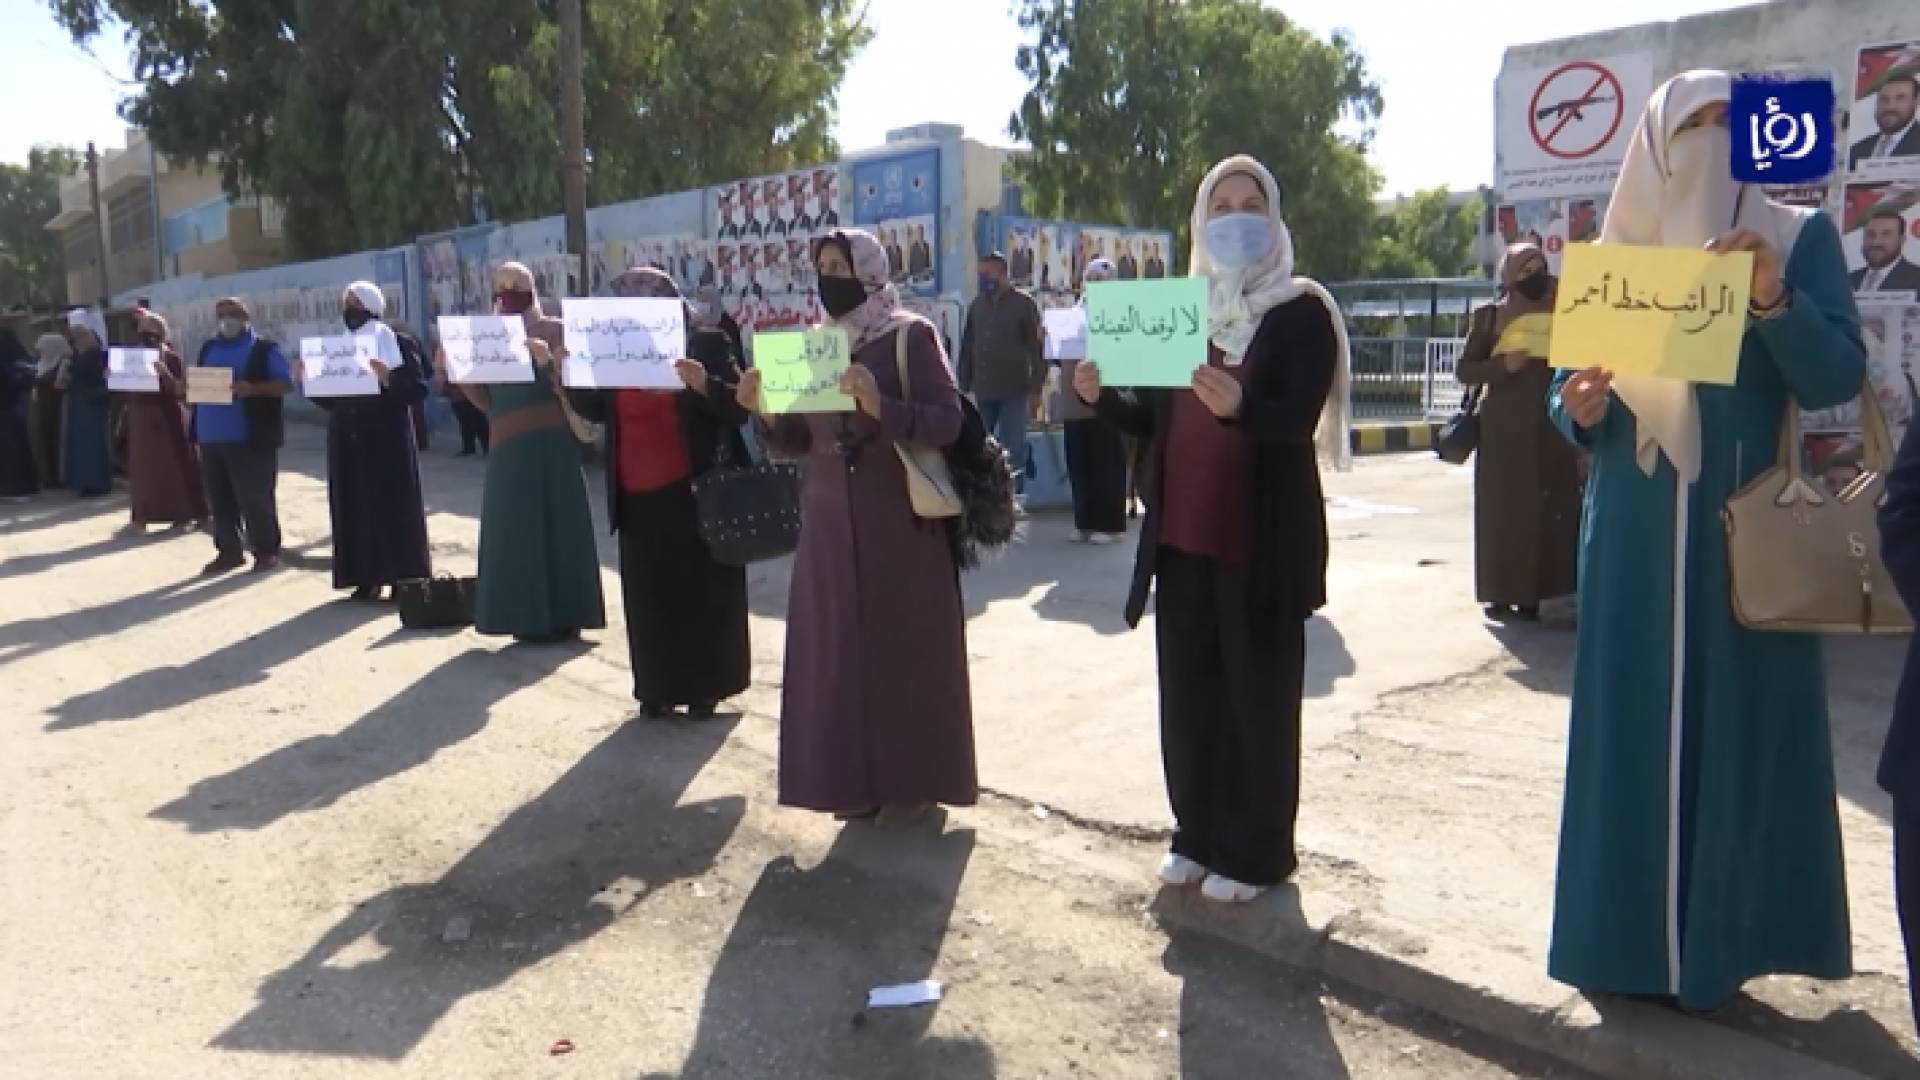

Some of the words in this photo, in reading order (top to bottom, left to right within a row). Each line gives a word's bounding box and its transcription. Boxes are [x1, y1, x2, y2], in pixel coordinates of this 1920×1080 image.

[1561, 271, 1611, 314] أحمر
[1611, 276, 1652, 310] خط
[1652, 283, 1735, 335] الراتب
[1141, 304, 1178, 342] لوقف
[1180, 302, 1200, 336] لا
